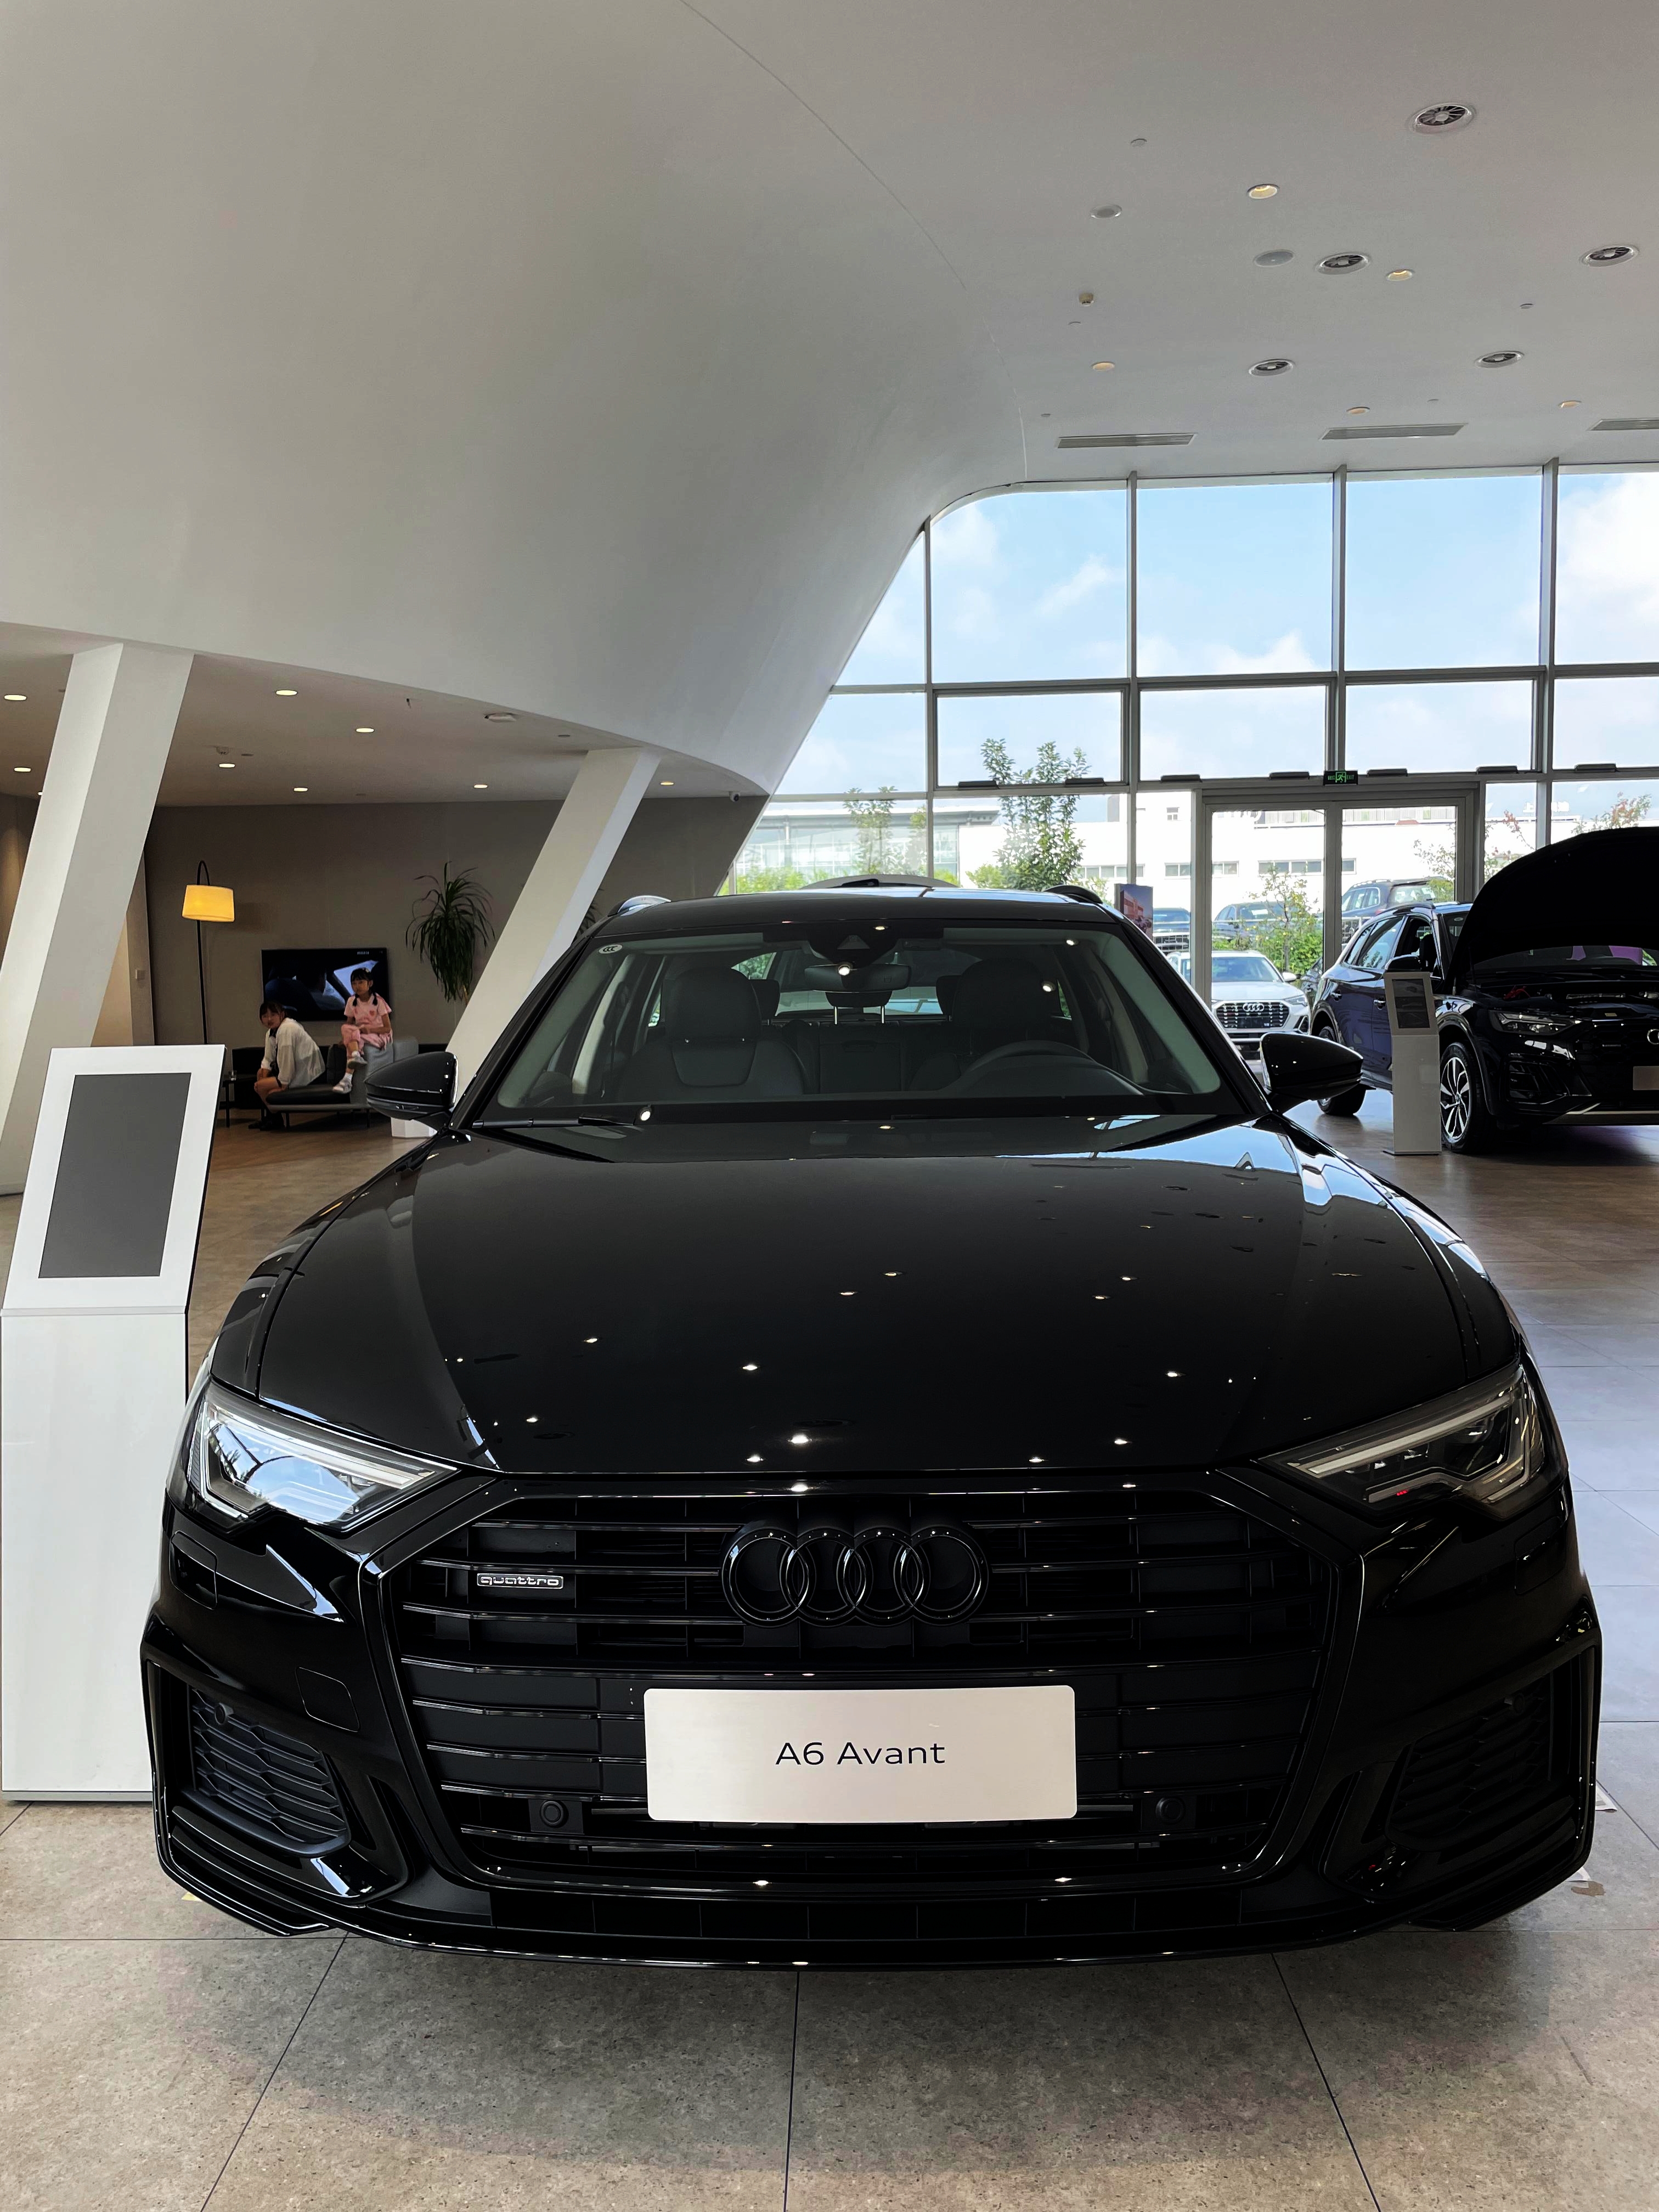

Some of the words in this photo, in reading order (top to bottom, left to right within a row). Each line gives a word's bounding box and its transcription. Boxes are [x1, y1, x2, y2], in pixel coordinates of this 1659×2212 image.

[480, 1576, 559, 1586] quattro
[775, 1742, 825, 1765] A6
[837, 1742, 945, 1765] Avant
